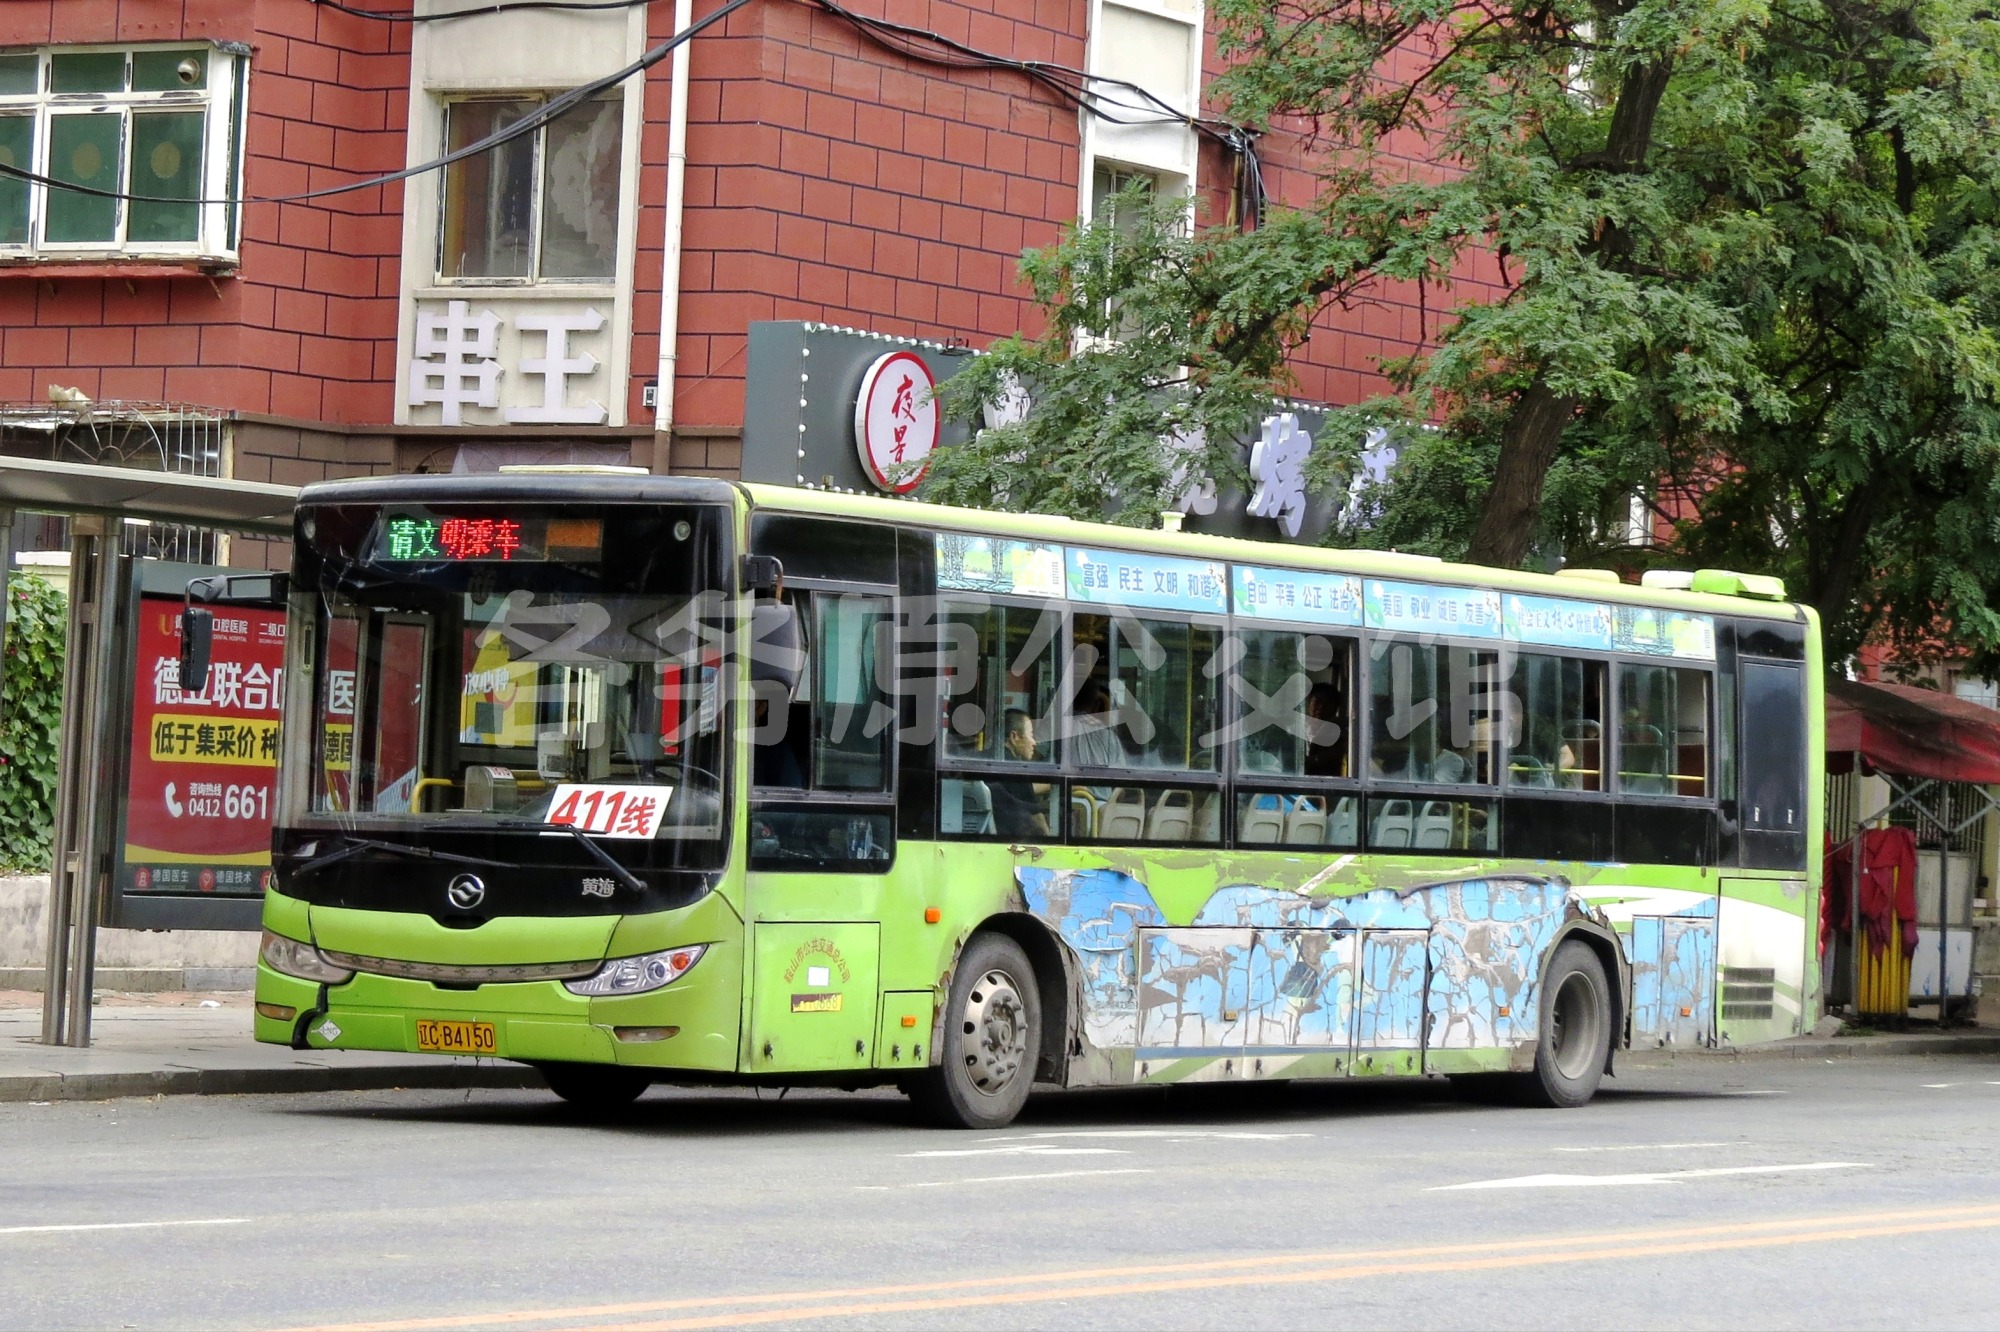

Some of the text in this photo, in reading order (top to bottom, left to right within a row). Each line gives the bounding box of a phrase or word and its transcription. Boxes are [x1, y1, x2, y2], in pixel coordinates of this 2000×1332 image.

[408, 300, 608, 426] 串王
[389, 519, 521, 560] 请文明乘车
[1083, 564, 1109, 589] 富强
[1119, 566, 1144, 592] 民主
[1153, 569, 1178, 595] 文明
[1187, 573, 1213, 599] 和谐
[1247, 581, 1350, 611] 自由 平等 公正 法治
[1383, 595, 1484, 626] 爱国 敬业 诚信 友善
[155, 721, 257, 759] 低于集采价
[189, 782, 222, 797] 咨询热线
[189, 785, 268, 820] 0412 661
[550, 790, 656, 837] 411线
[152, 869, 189, 883] 德国医生
[216, 870, 252, 884] 德国技术
[581, 878, 615, 898] 黄海
